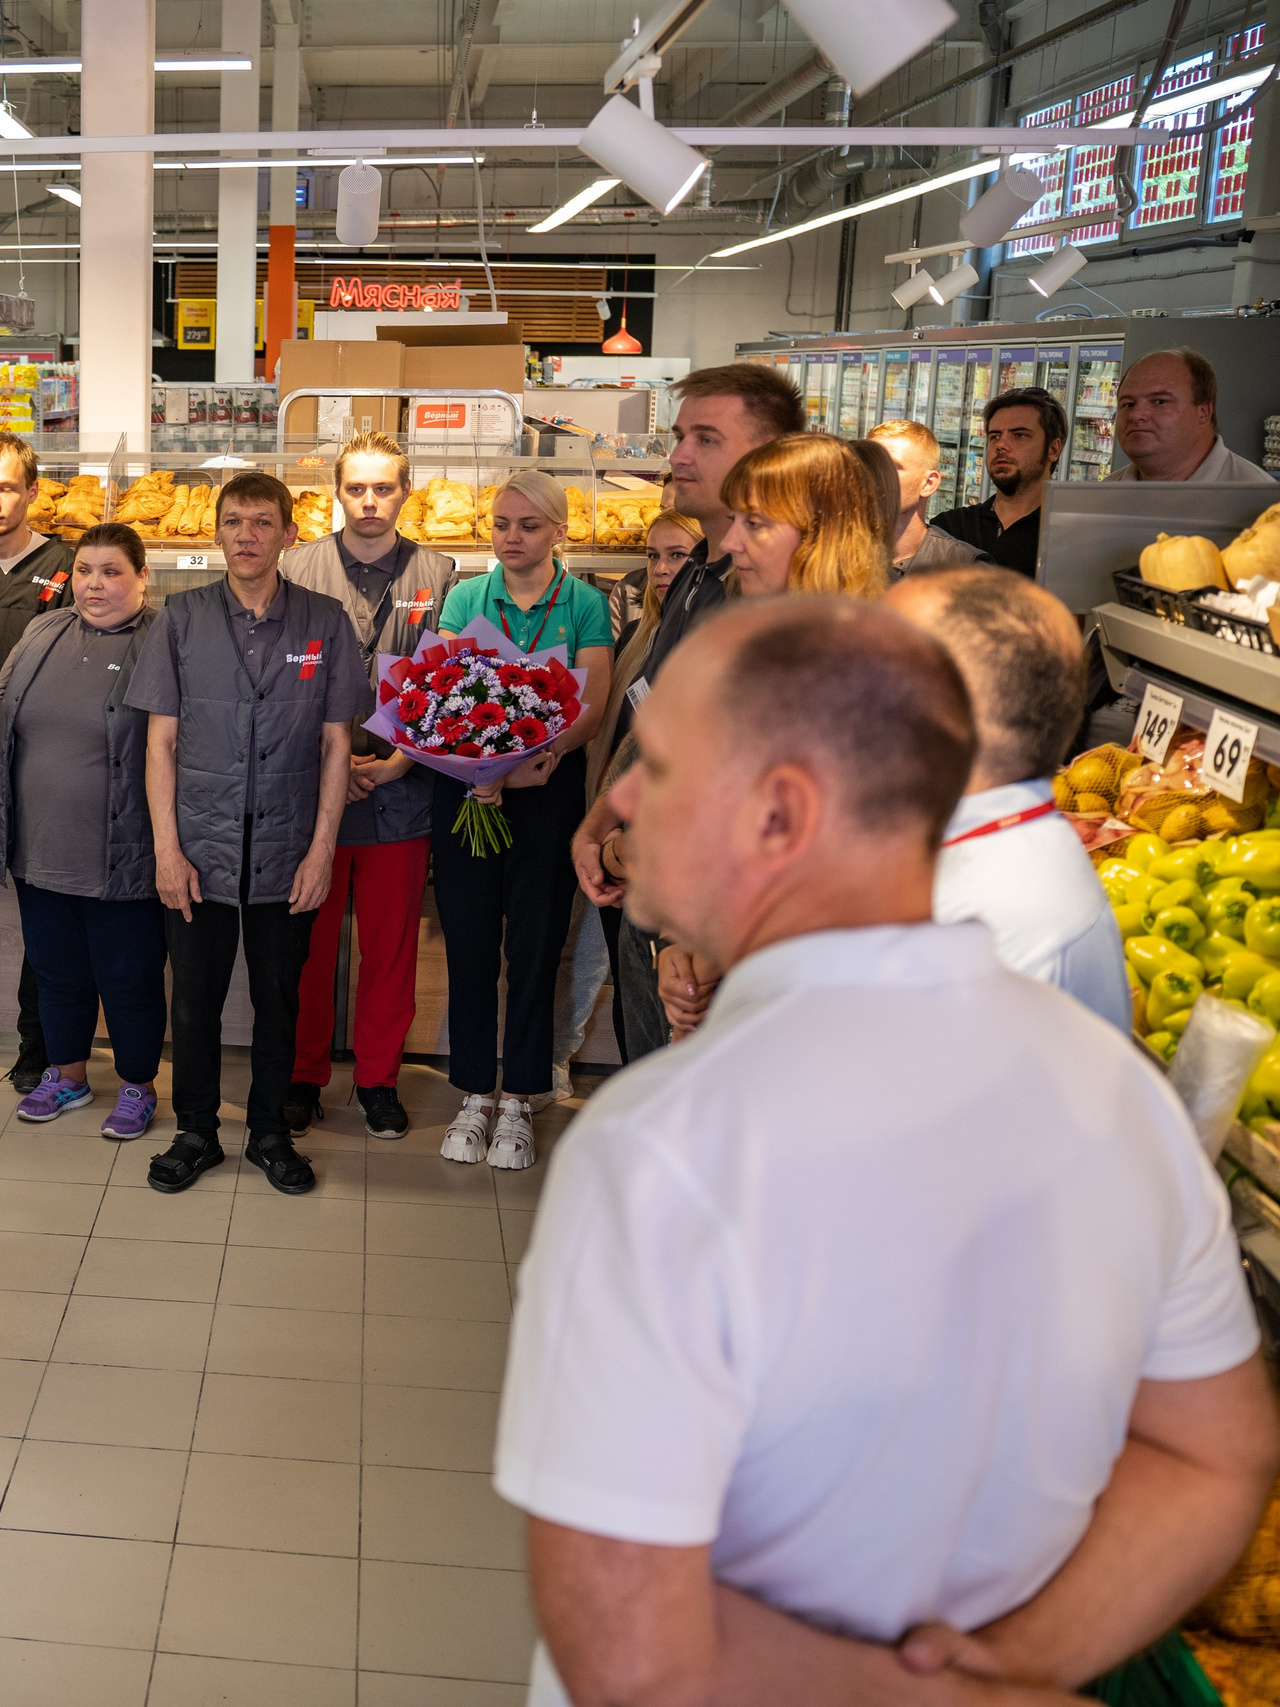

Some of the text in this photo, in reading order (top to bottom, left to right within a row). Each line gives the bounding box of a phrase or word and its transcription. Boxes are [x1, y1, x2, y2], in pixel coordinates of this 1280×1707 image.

[330, 277, 460, 308] Мясная
[424, 410, 459, 420] Верный
[190, 556, 203, 565] 32
[31, 575, 66, 590] Верный
[395, 598, 435, 609] Верный
[286, 651, 323, 664] Верный
[1140, 710, 1168, 747] 149
[1213, 734, 1241, 778] 69
